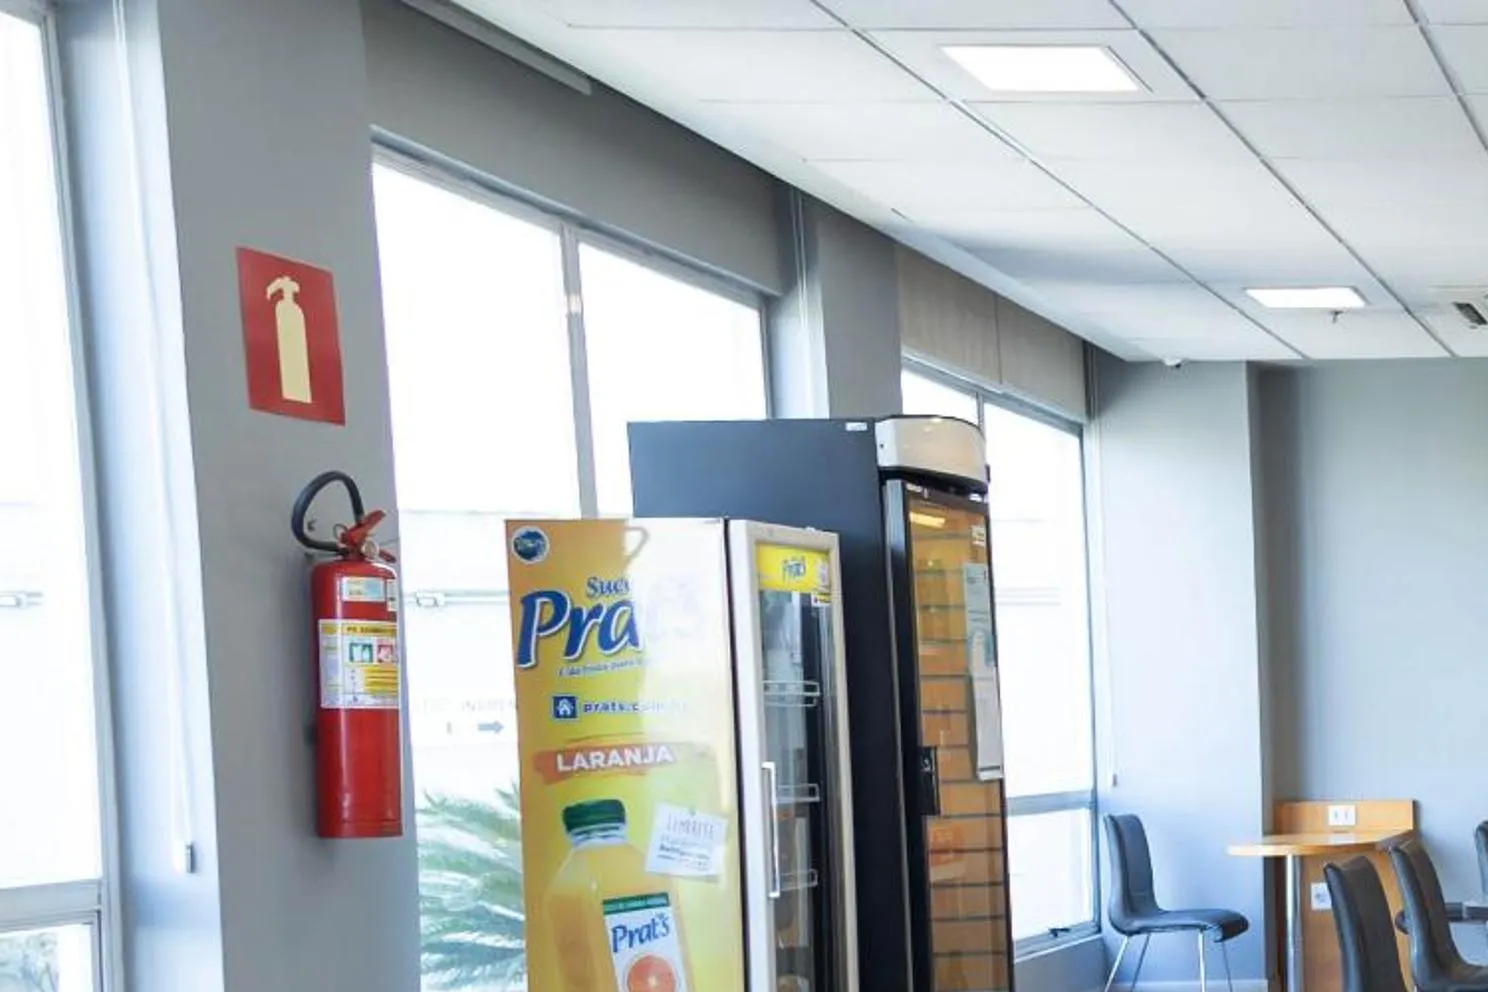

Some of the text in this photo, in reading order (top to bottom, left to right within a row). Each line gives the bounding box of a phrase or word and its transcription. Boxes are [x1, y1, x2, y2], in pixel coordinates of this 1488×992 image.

[517, 589, 662, 668] Pra
[556, 745, 674, 773] LARANJA
[612, 915, 670, 953] Prat's
